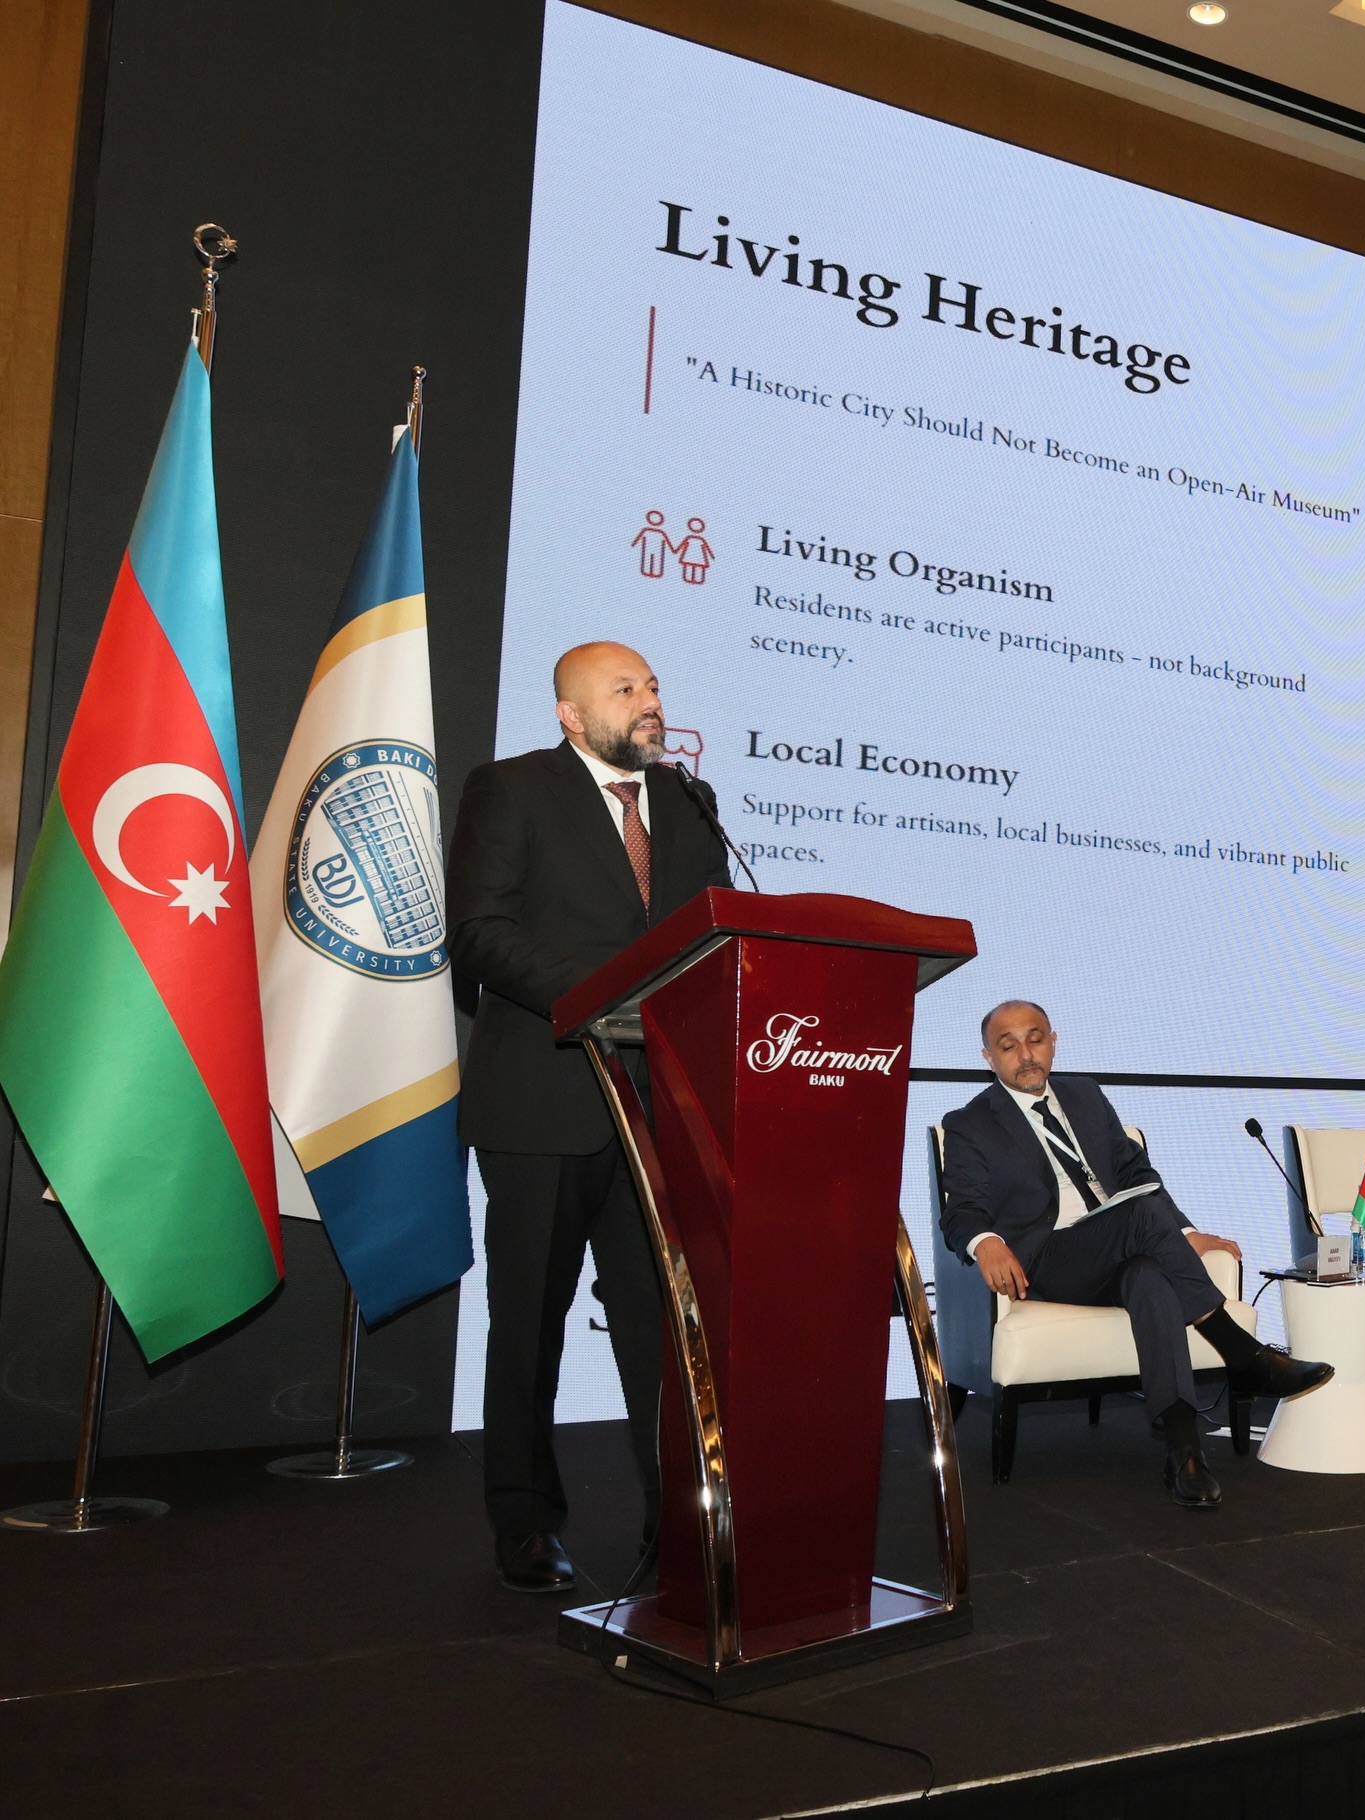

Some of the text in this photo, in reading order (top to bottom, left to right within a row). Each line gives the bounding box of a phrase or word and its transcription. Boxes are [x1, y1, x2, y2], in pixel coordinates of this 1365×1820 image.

[655, 200, 1191, 395] Living Heritage
[686, 356, 1361, 524] "A Historic City Should Not Become an Open-Air Museum"
[757, 525, 1053, 603] Living Organism
[750, 635, 853, 669] scenery.
[754, 585, 873, 623] Residents
[880, 613, 916, 631] are
[923, 619, 991, 643] active
[998, 631, 1125, 664] participants
[1149, 655, 1184, 674] not
[1189, 654, 1306, 693] background
[377, 749, 421, 768] BAKI
[746, 730, 1019, 797] Local Economy
[299, 773, 331, 822] BAKU
[736, 842, 824, 873] spaces.
[742, 793, 1350, 875] Support for artisans, local businesses, and vibrant public
[305, 884, 320, 904] 1919
[295, 907, 416, 971] UNIVERSITY
[746, 1012, 903, 1076] Fairmont
[809, 1074, 845, 1087] BAKU
